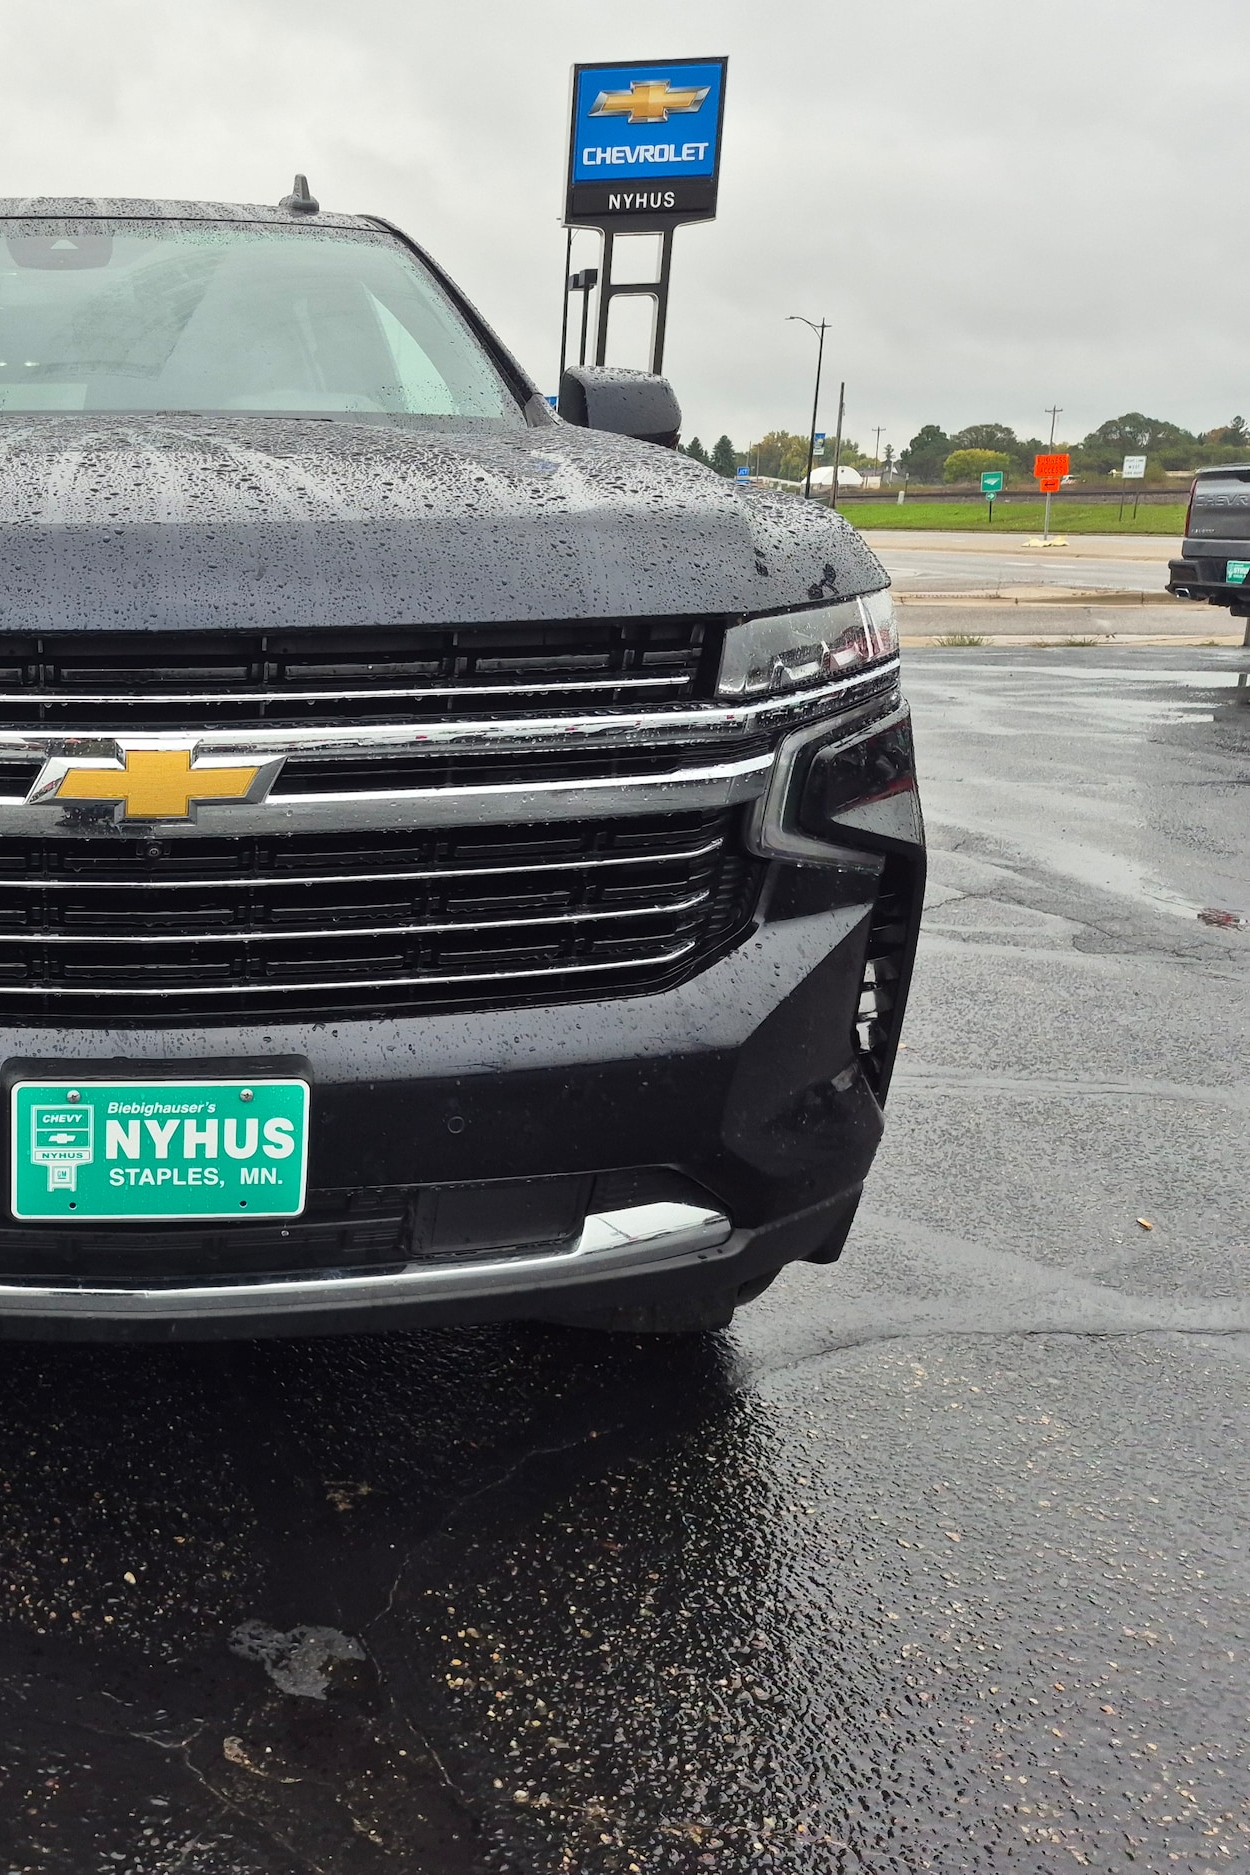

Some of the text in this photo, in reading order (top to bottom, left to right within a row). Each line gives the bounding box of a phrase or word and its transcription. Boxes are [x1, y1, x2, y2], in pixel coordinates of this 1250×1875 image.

[582, 142, 709, 166] CHEVROLET
[608, 191, 676, 210] NYHUS
[42, 1114, 83, 1123] CHEVY
[107, 1101, 217, 1117] Biebighauser's
[105, 1117, 296, 1160] NYHUS
[109, 1167, 284, 1189] STAPLES, MN.
